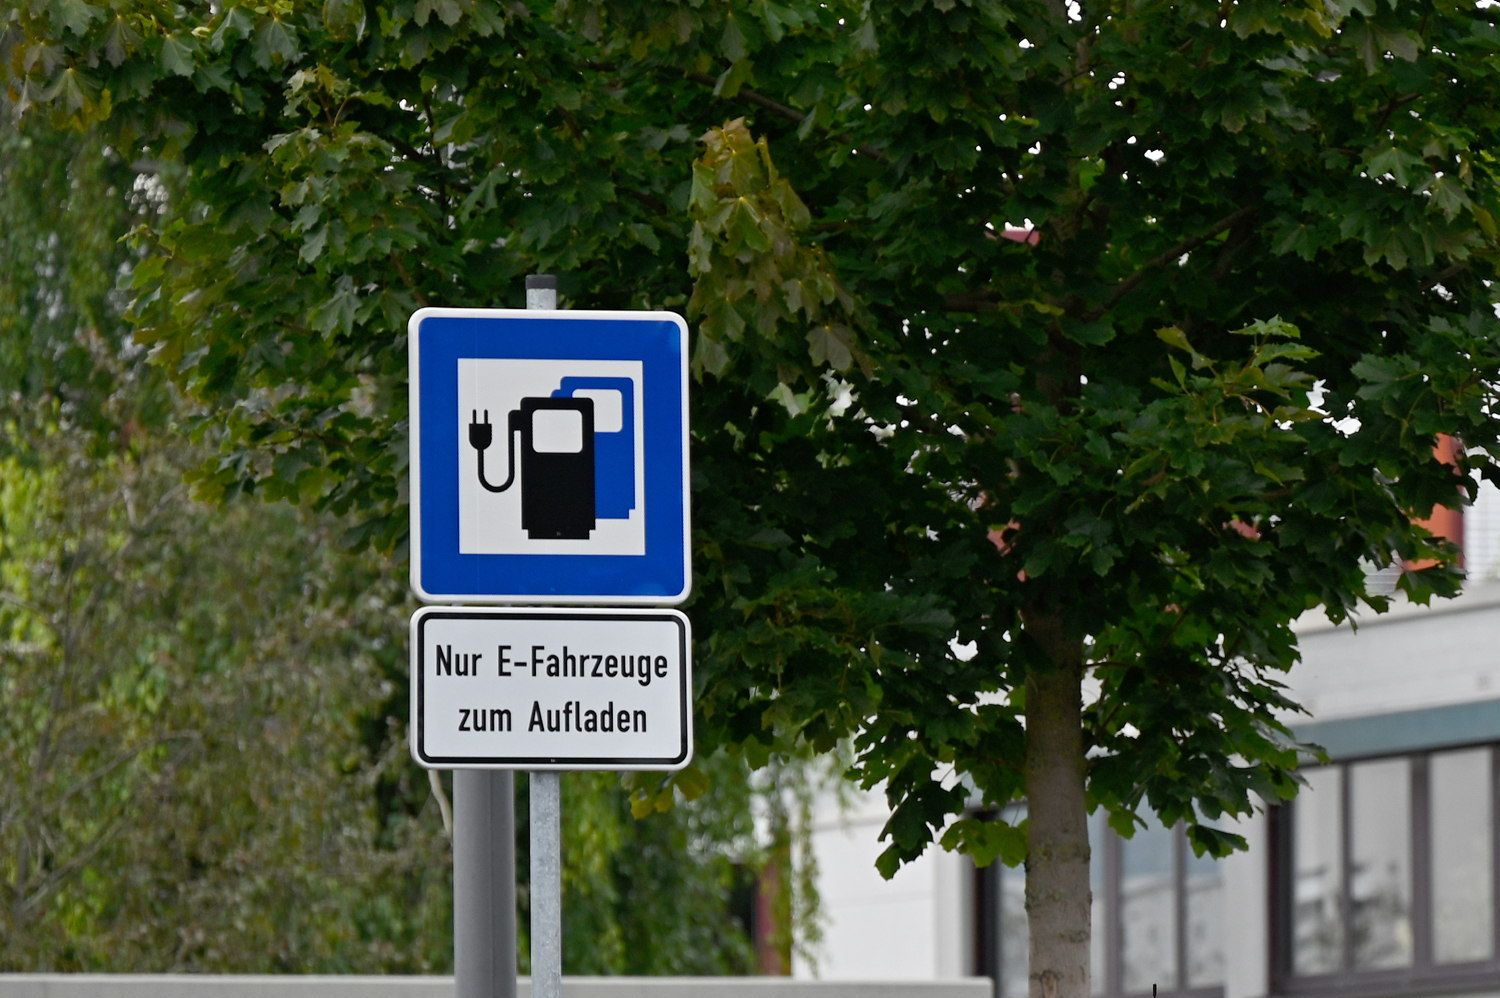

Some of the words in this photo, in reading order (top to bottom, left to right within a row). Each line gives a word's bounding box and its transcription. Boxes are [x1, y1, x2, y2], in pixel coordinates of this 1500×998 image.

[436, 645, 482, 676] Nur
[498, 645, 668, 686] E-Fahrzeuge
[458, 708, 512, 732] zum
[528, 701, 647, 733] Aufladen
